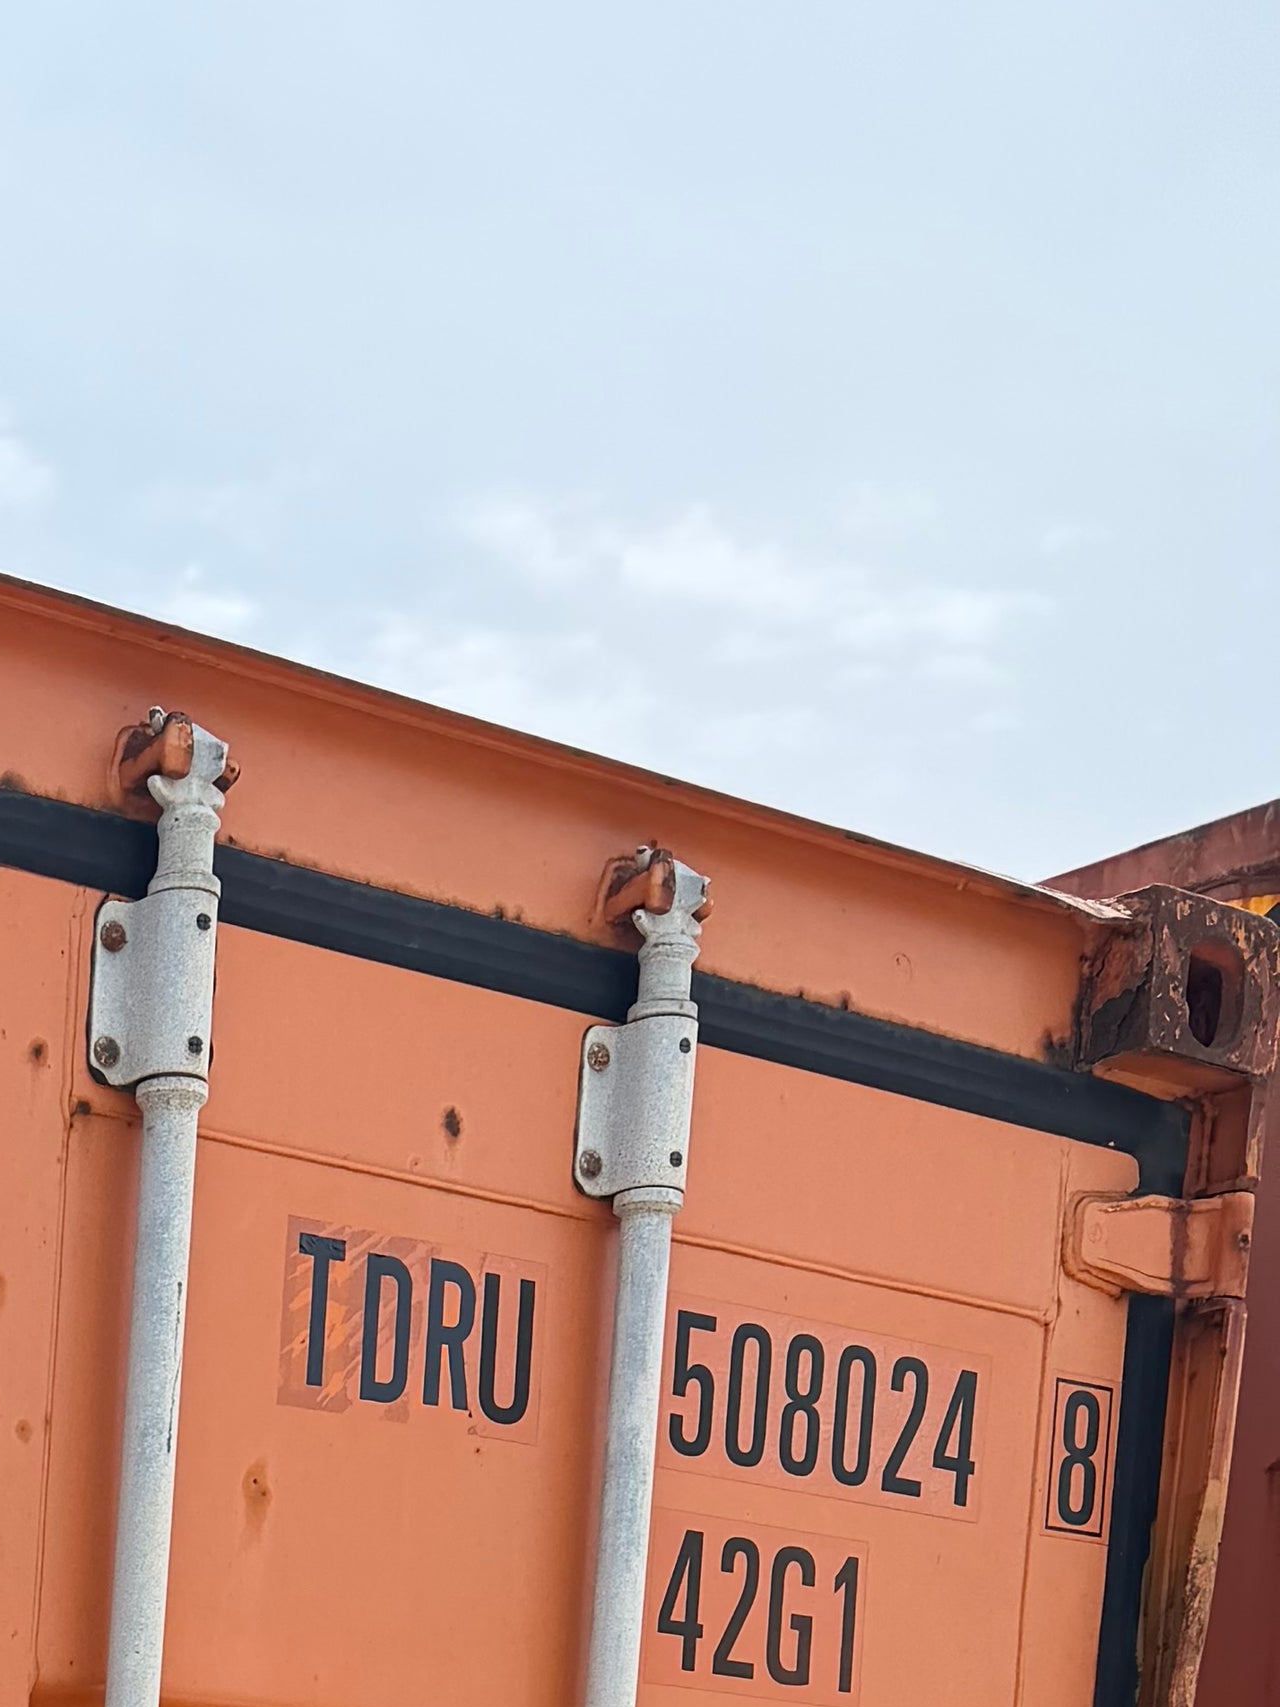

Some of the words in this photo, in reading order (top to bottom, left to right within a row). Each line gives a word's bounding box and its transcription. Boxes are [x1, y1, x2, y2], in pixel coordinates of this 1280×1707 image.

[297, 1232, 536, 1425] TDRU
[668, 1309, 979, 1507] 508024
[1058, 1390, 1100, 1528] 8
[656, 1529, 860, 1694] 42G1
